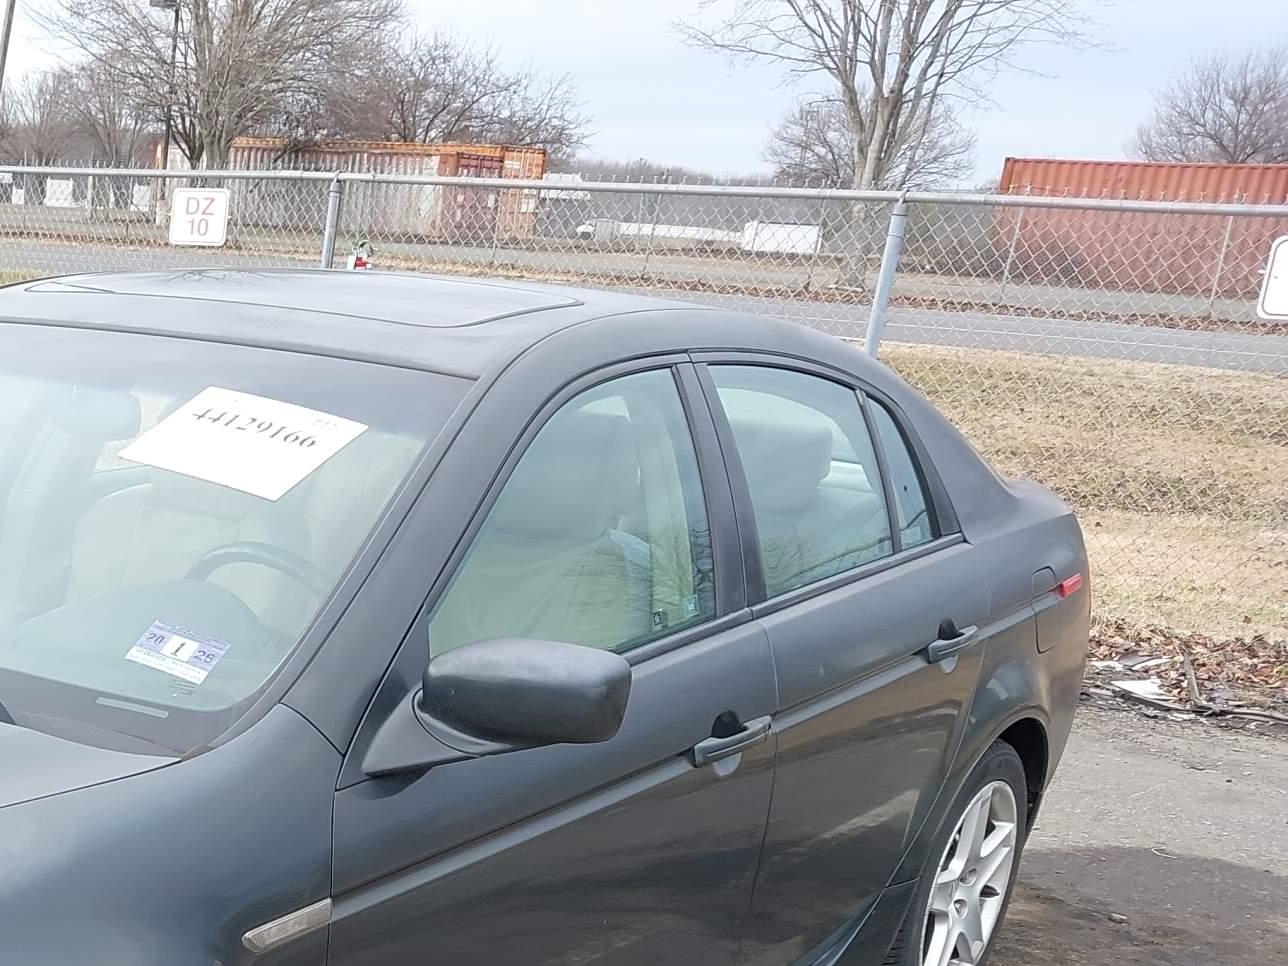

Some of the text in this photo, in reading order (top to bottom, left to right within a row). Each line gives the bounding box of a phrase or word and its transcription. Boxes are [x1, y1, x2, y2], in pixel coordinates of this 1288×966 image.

[185, 197, 216, 216] DZ
[187, 218, 209, 237] 10
[192, 408, 317, 448] 44129166
[145, 632, 216, 664] 20 1 26
